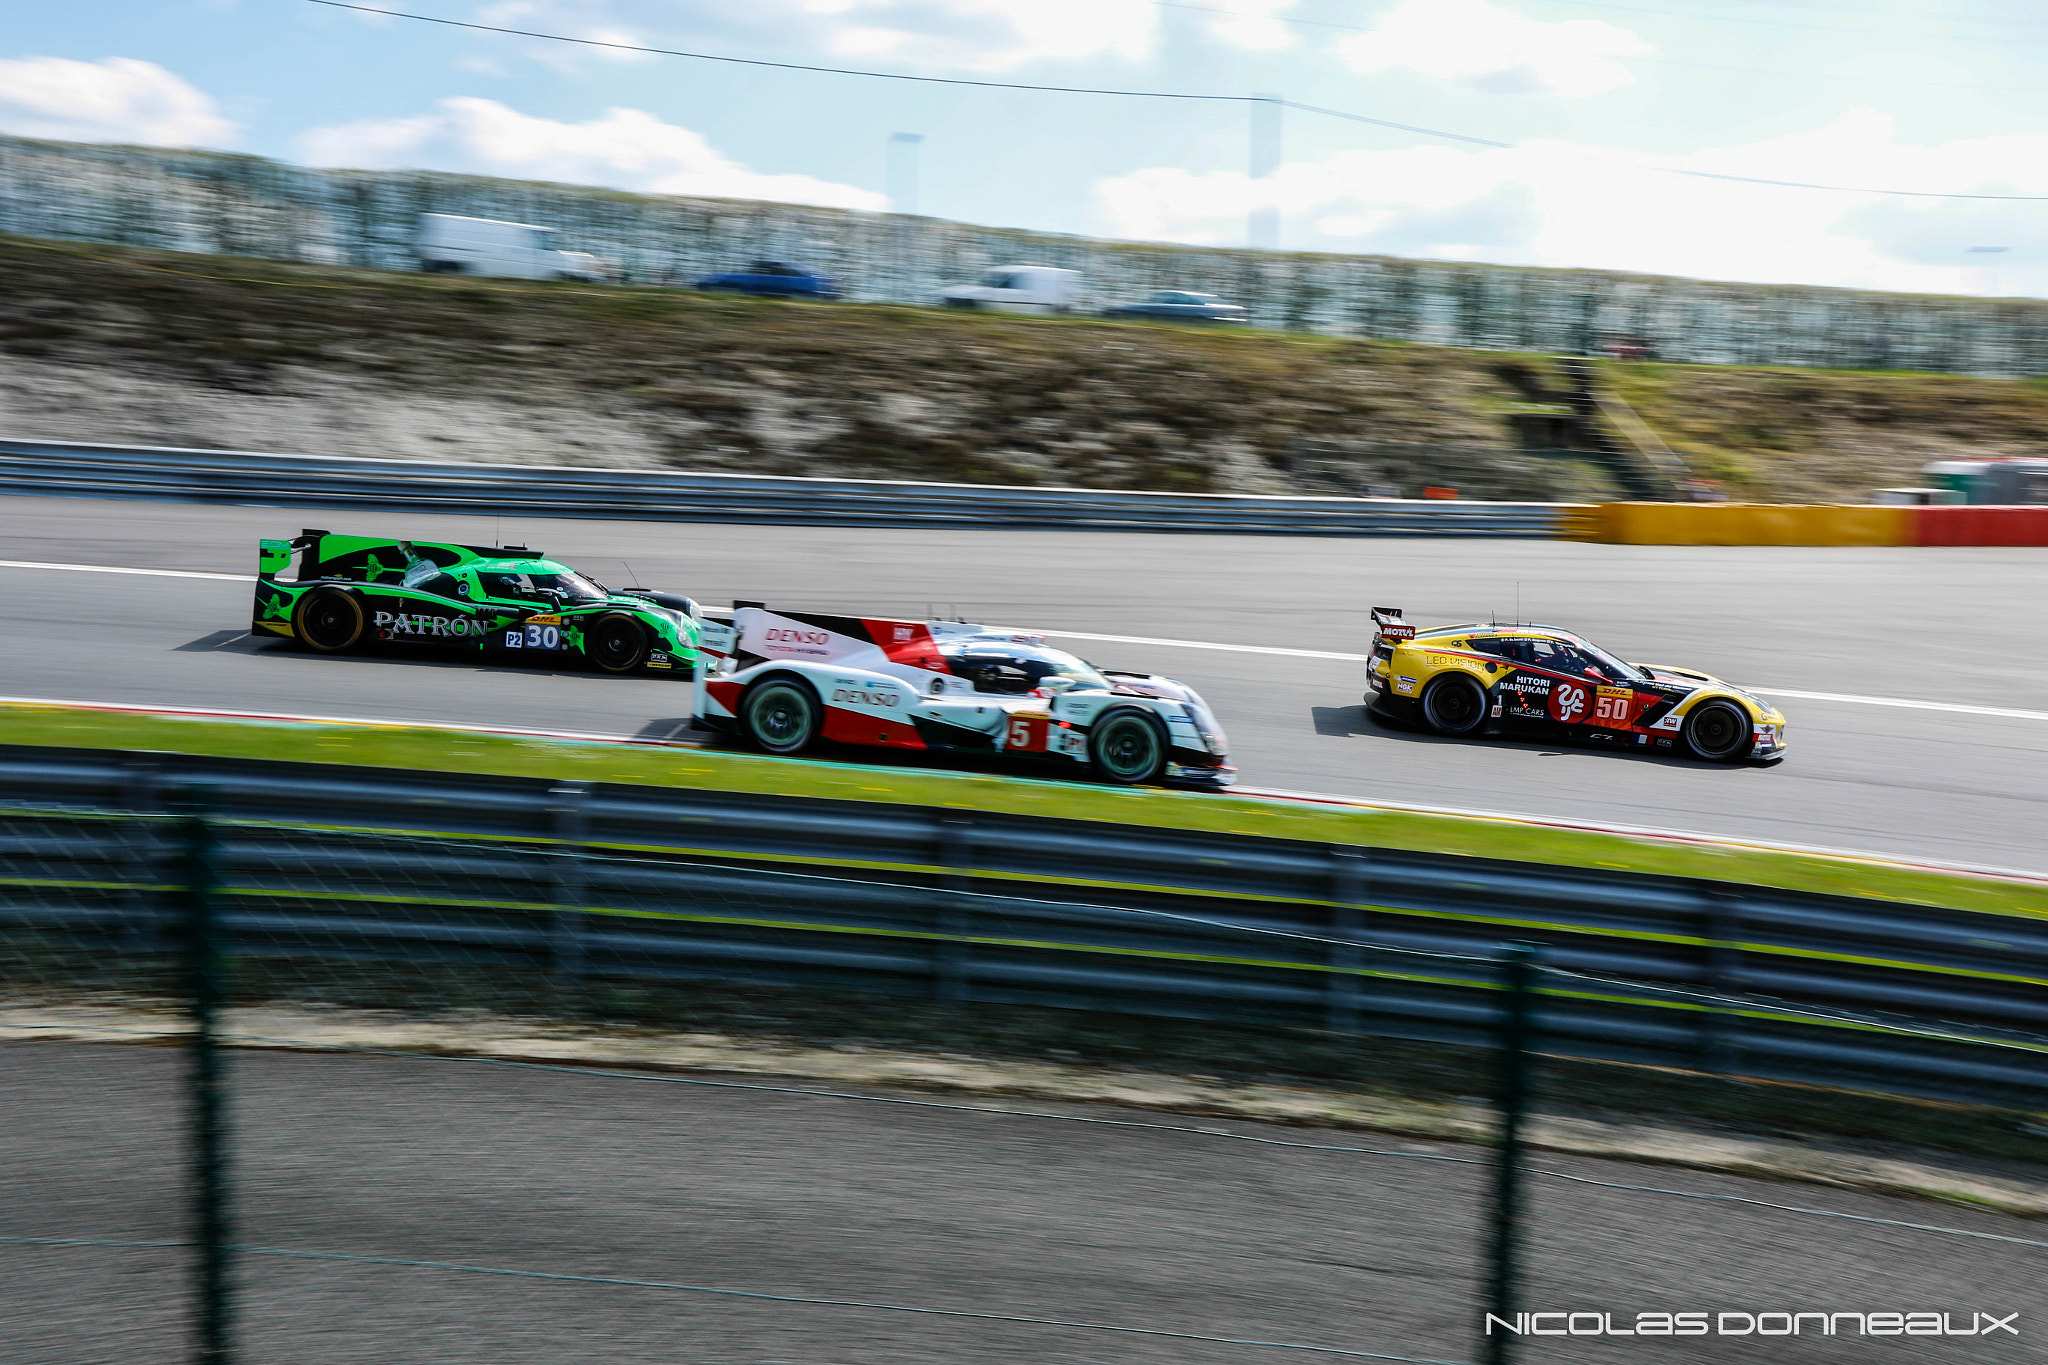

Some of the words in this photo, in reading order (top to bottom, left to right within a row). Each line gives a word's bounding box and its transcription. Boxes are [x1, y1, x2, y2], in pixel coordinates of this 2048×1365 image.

[373, 610, 490, 638] PATRÓN
[529, 615, 556, 623] DHL
[526, 625, 559, 648] 30
[765, 628, 830, 646] DENSO
[1383, 627, 1414, 637] MOTUL
[507, 634, 521, 646] P2
[1516, 675, 1550, 687] HITORI
[1499, 682, 1550, 695] MARUKAN
[1602, 687, 1628, 696] DHL
[832, 688, 900, 707] DENSO
[1525, 707, 1545, 716] CARS
[1596, 696, 1629, 720] 50
[1009, 720, 1031, 748] 5
